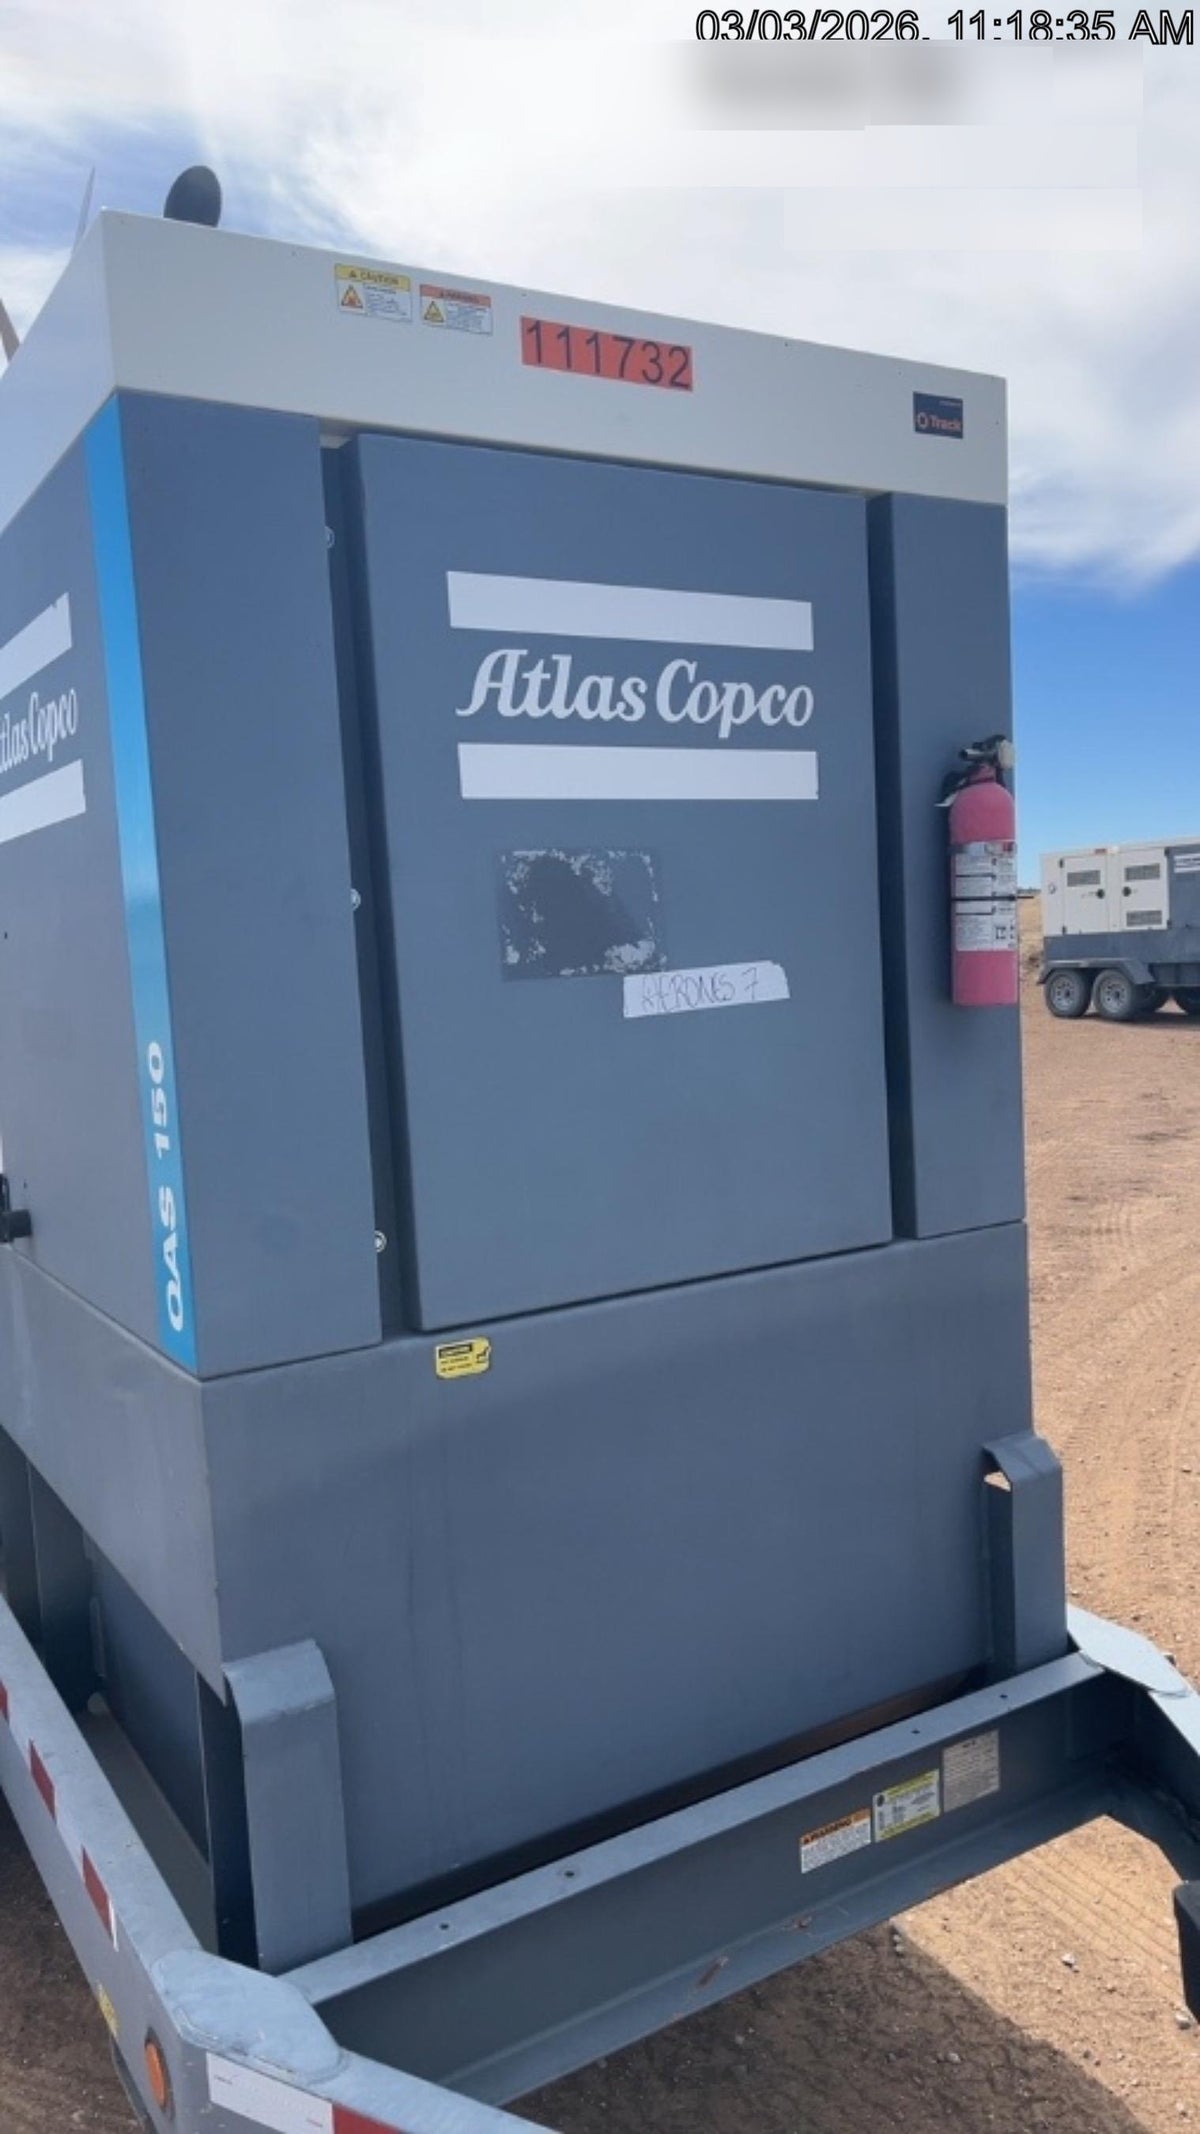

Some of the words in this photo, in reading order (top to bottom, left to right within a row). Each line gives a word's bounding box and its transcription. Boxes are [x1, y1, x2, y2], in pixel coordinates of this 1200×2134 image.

[526, 319, 691, 389] 111732
[0, 712, 28, 774] tlas
[28, 687, 79, 762] Copco
[455, 648, 648, 723] Atlas
[655, 658, 815, 740] Copco
[742, 967, 759, 1001] 7
[148, 1041, 171, 1160] 150
[158, 1186, 184, 1332] QAS
